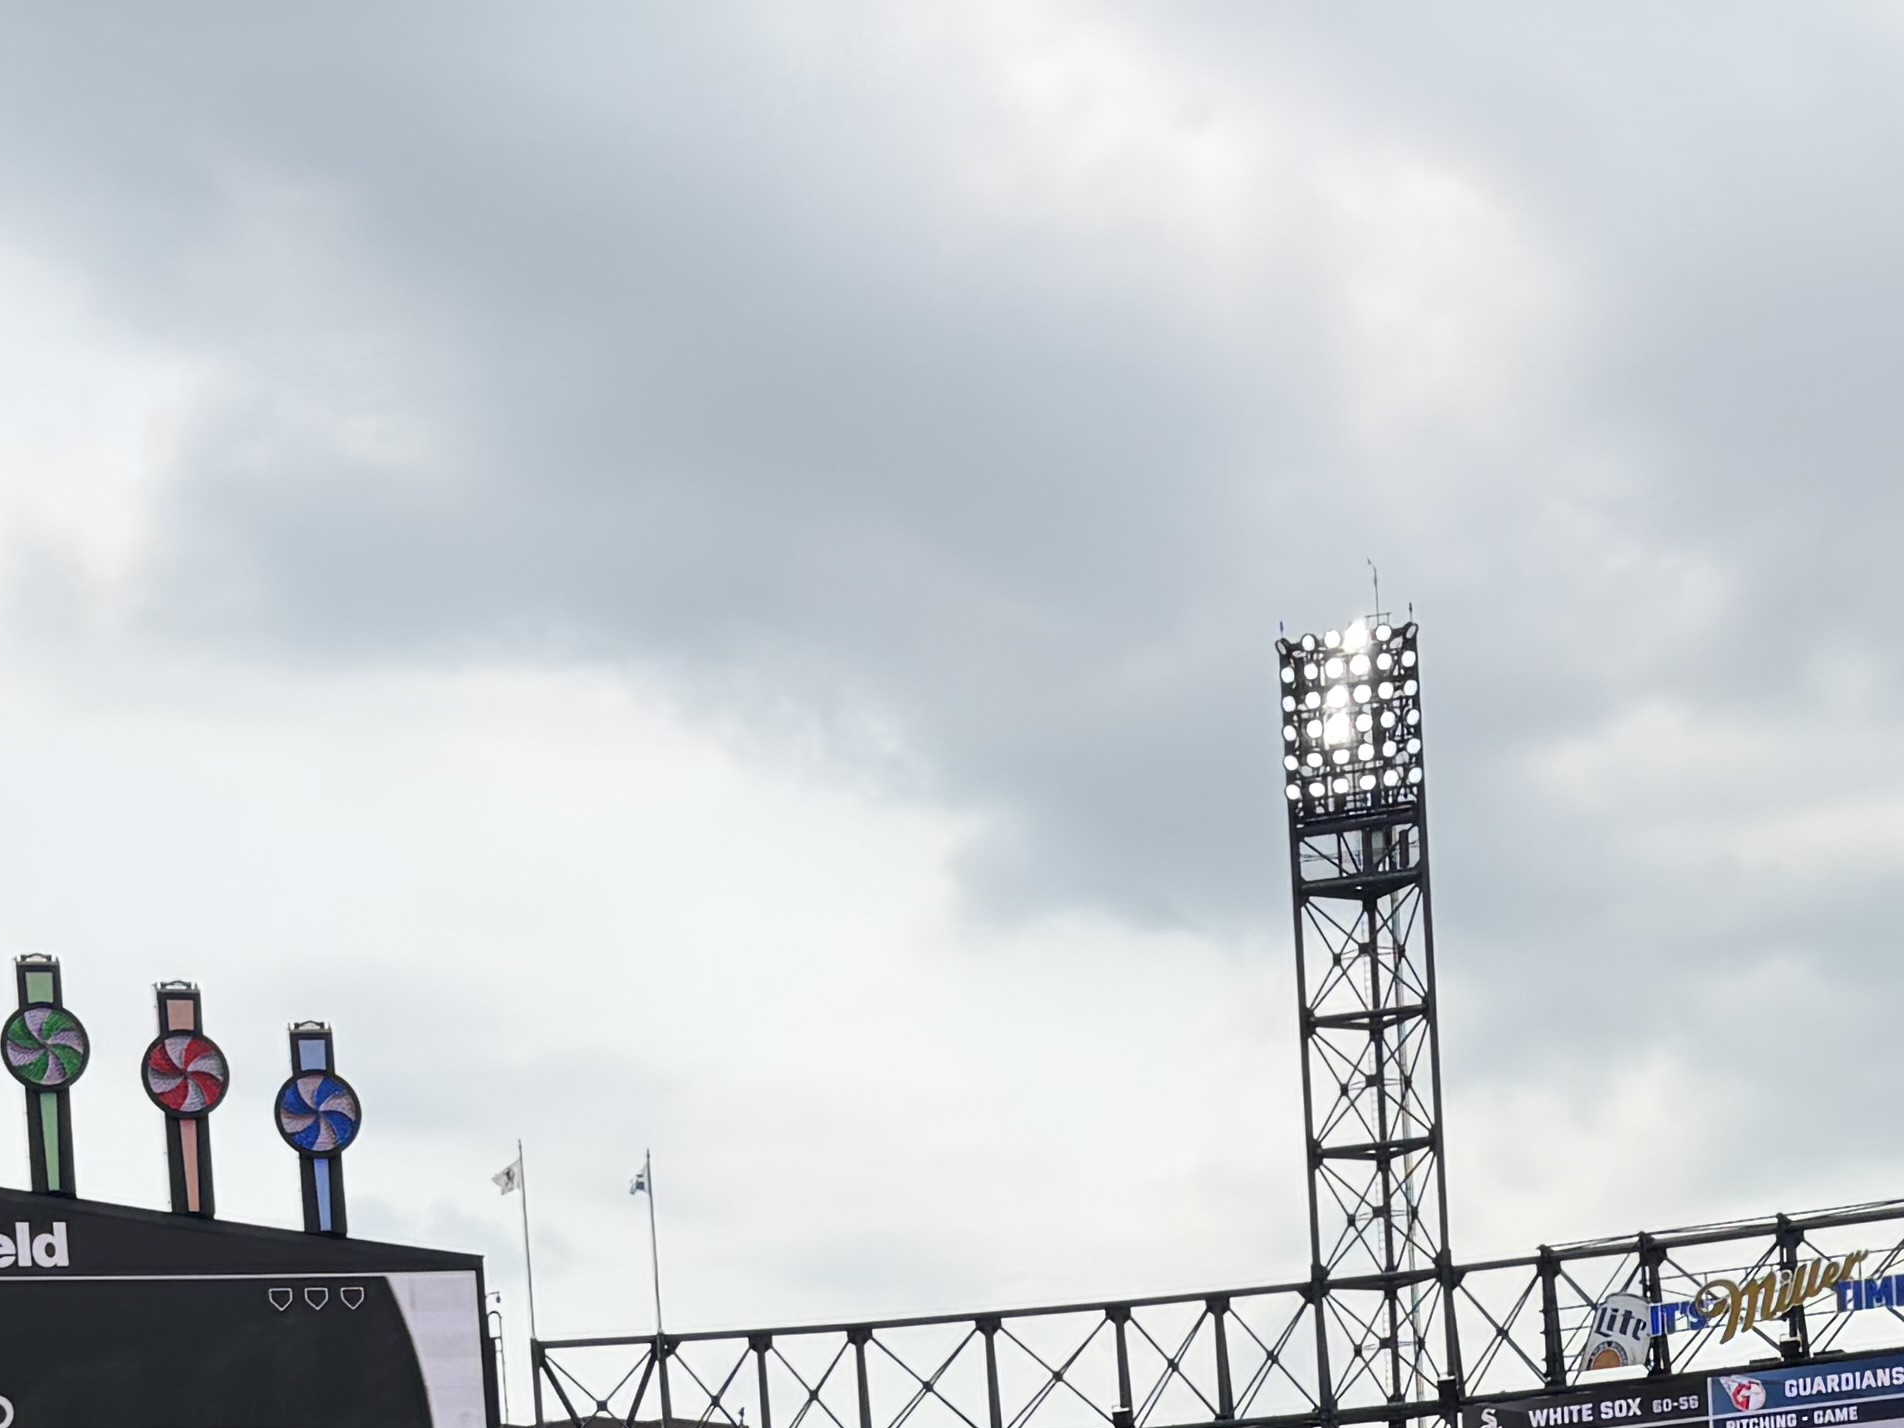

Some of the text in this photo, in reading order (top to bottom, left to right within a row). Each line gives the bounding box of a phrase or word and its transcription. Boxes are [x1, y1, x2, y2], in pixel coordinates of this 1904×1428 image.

[1696, 1249, 1869, 1344] Miller
[1595, 1304, 1648, 1341] Lite
[1784, 1366, 1904, 1398] GUARDIANS
[1528, 1395, 1699, 1428] WHITE SOX 60-56
[1814, 1406, 1858, 1425] GAME
